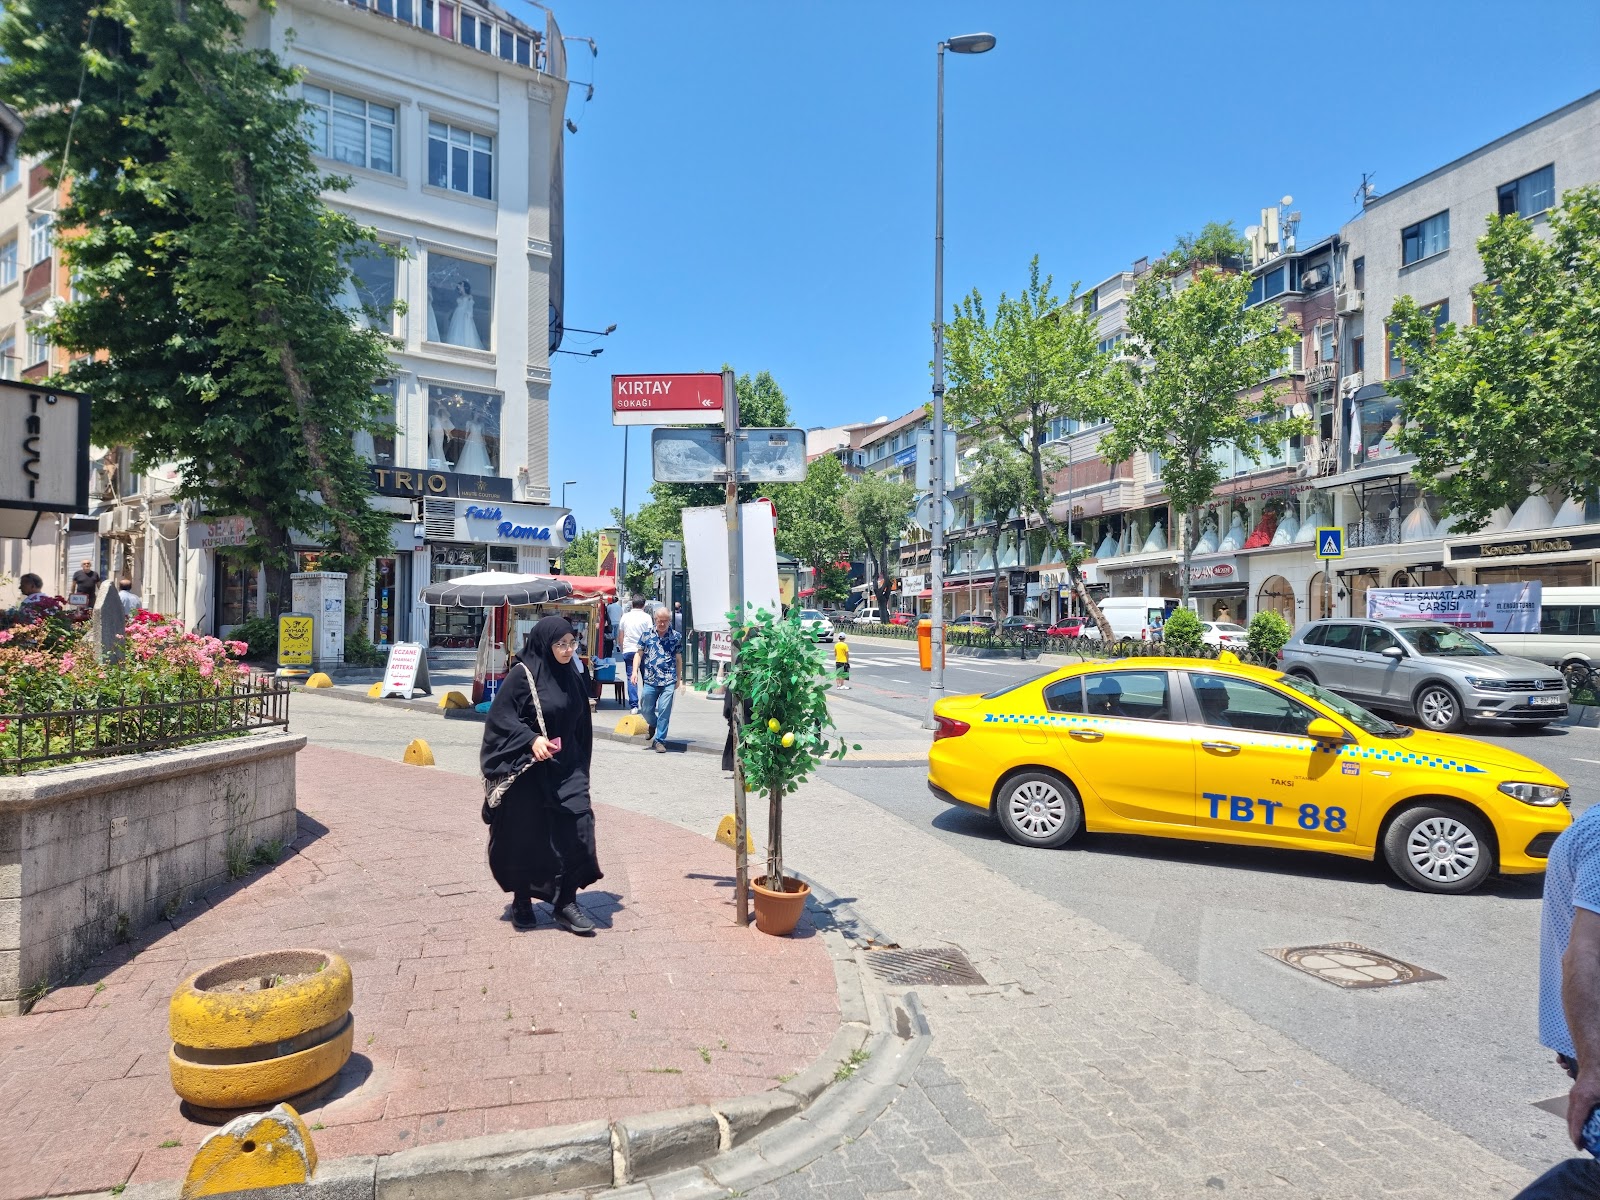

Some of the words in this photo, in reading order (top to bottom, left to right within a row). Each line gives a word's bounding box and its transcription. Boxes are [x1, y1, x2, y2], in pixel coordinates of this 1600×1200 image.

[618, 381, 672, 395] KIRTAY
[617, 399, 651, 407] SOKAĞI
[374, 468, 447, 493] TRIO
[465, 505, 503, 520] Fatih
[498, 521, 551, 540] Roma
[1417, 589, 1476, 602] SANATLARI
[1202, 792, 1283, 826] TBT
[1297, 803, 1347, 833] 88
